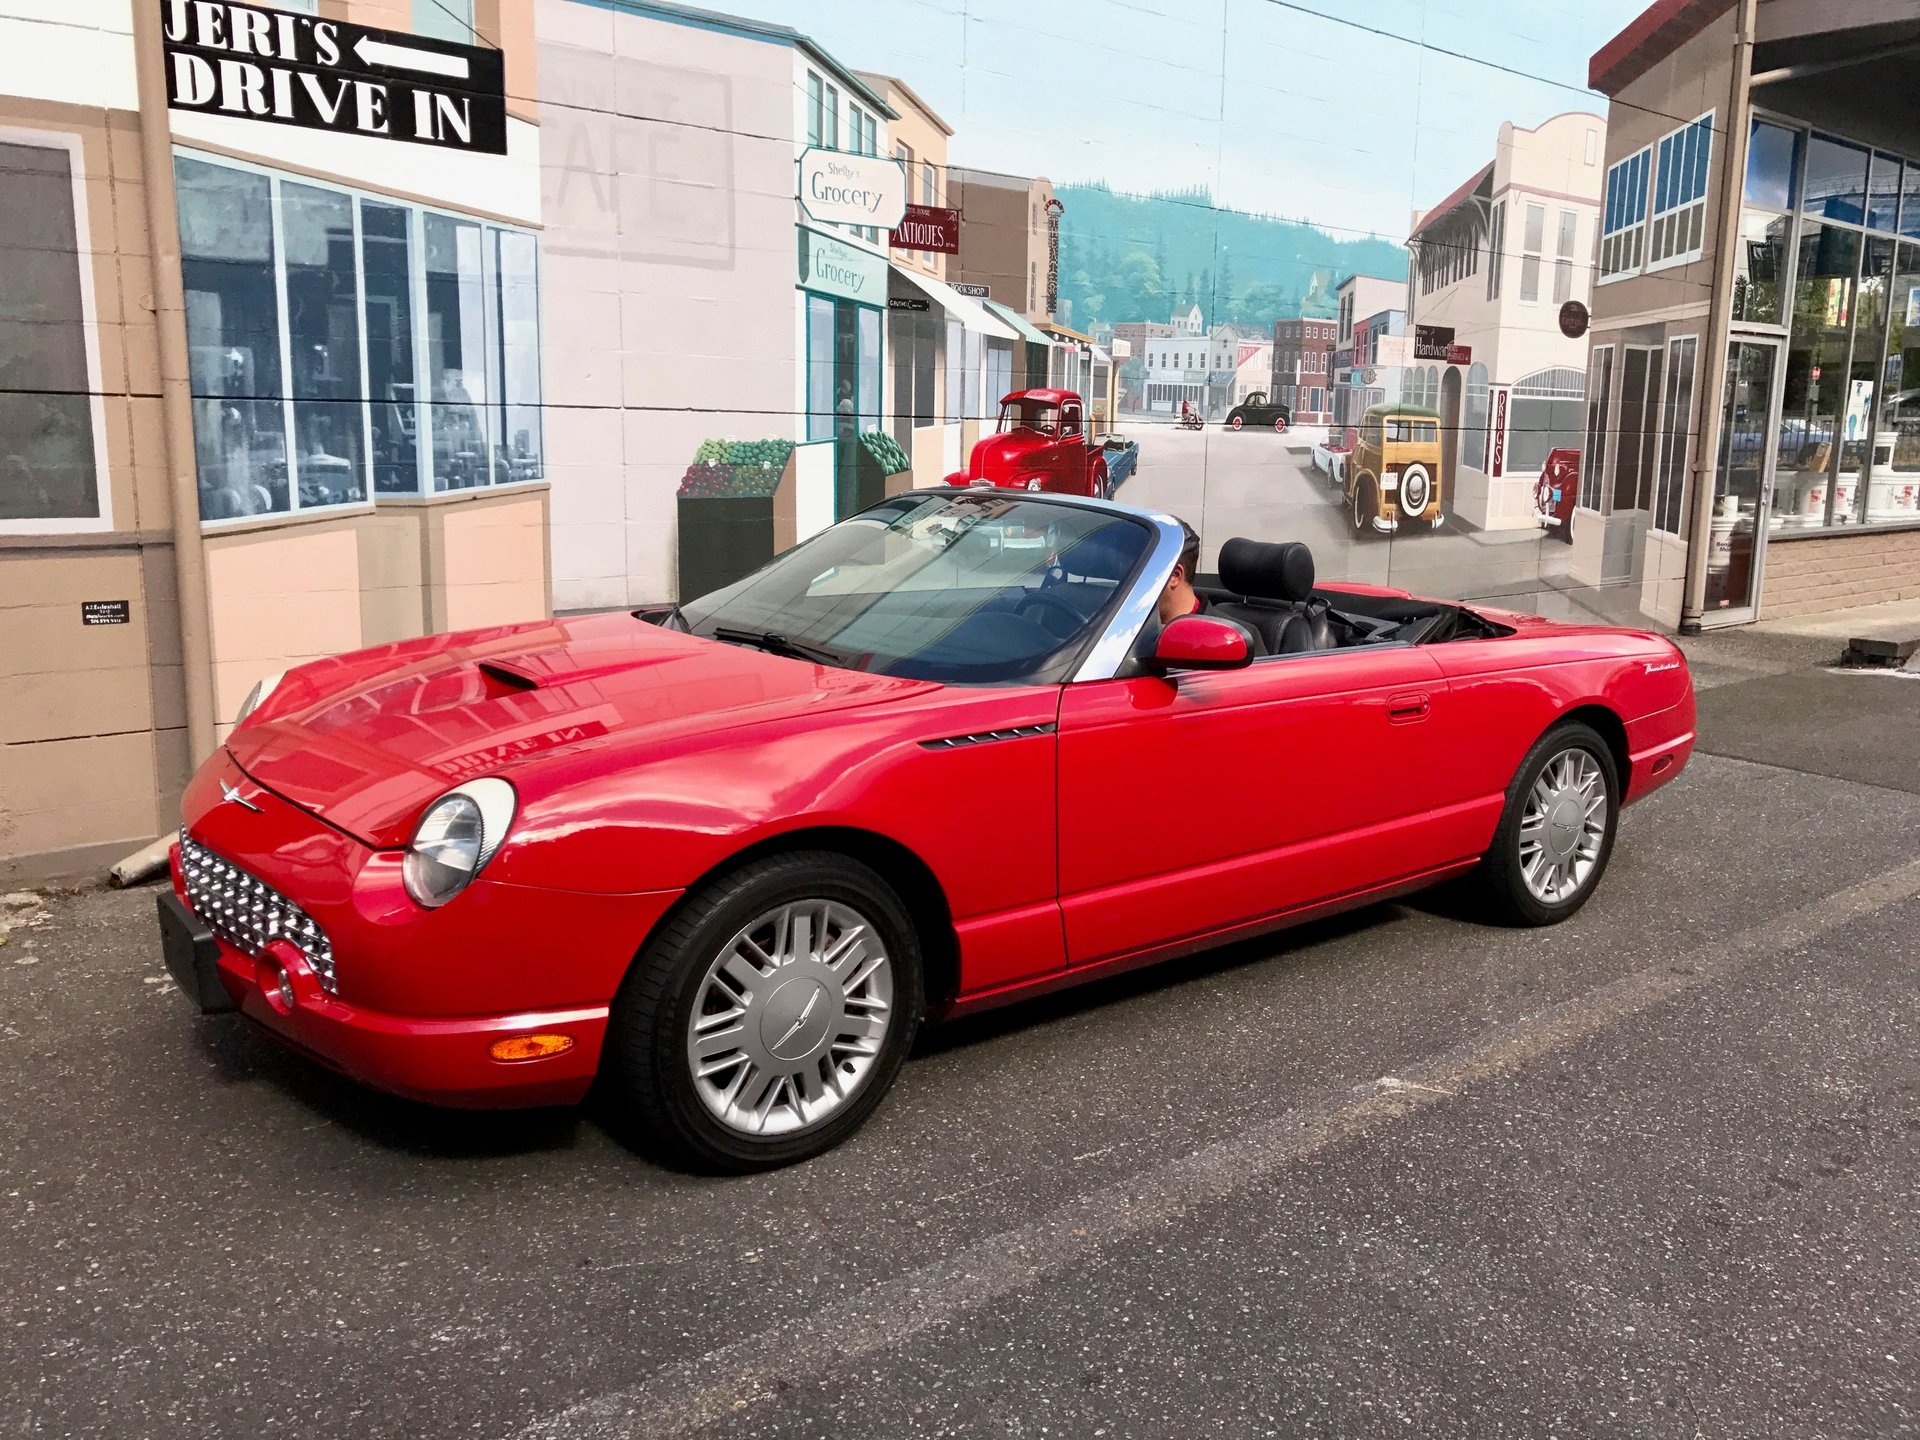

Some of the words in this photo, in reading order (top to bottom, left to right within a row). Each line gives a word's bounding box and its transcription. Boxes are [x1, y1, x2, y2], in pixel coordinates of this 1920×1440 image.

[164, 0, 340, 66] JERI'S
[170, 51, 389, 133] DRIVE
[411, 89, 472, 143] IN
[543, 120, 686, 222] AFE
[811, 171, 883, 213] Grocery
[892, 221, 945, 247] ANTIQUES
[816, 247, 866, 294] Grocery
[1494, 392, 1506, 465] DRUGS
